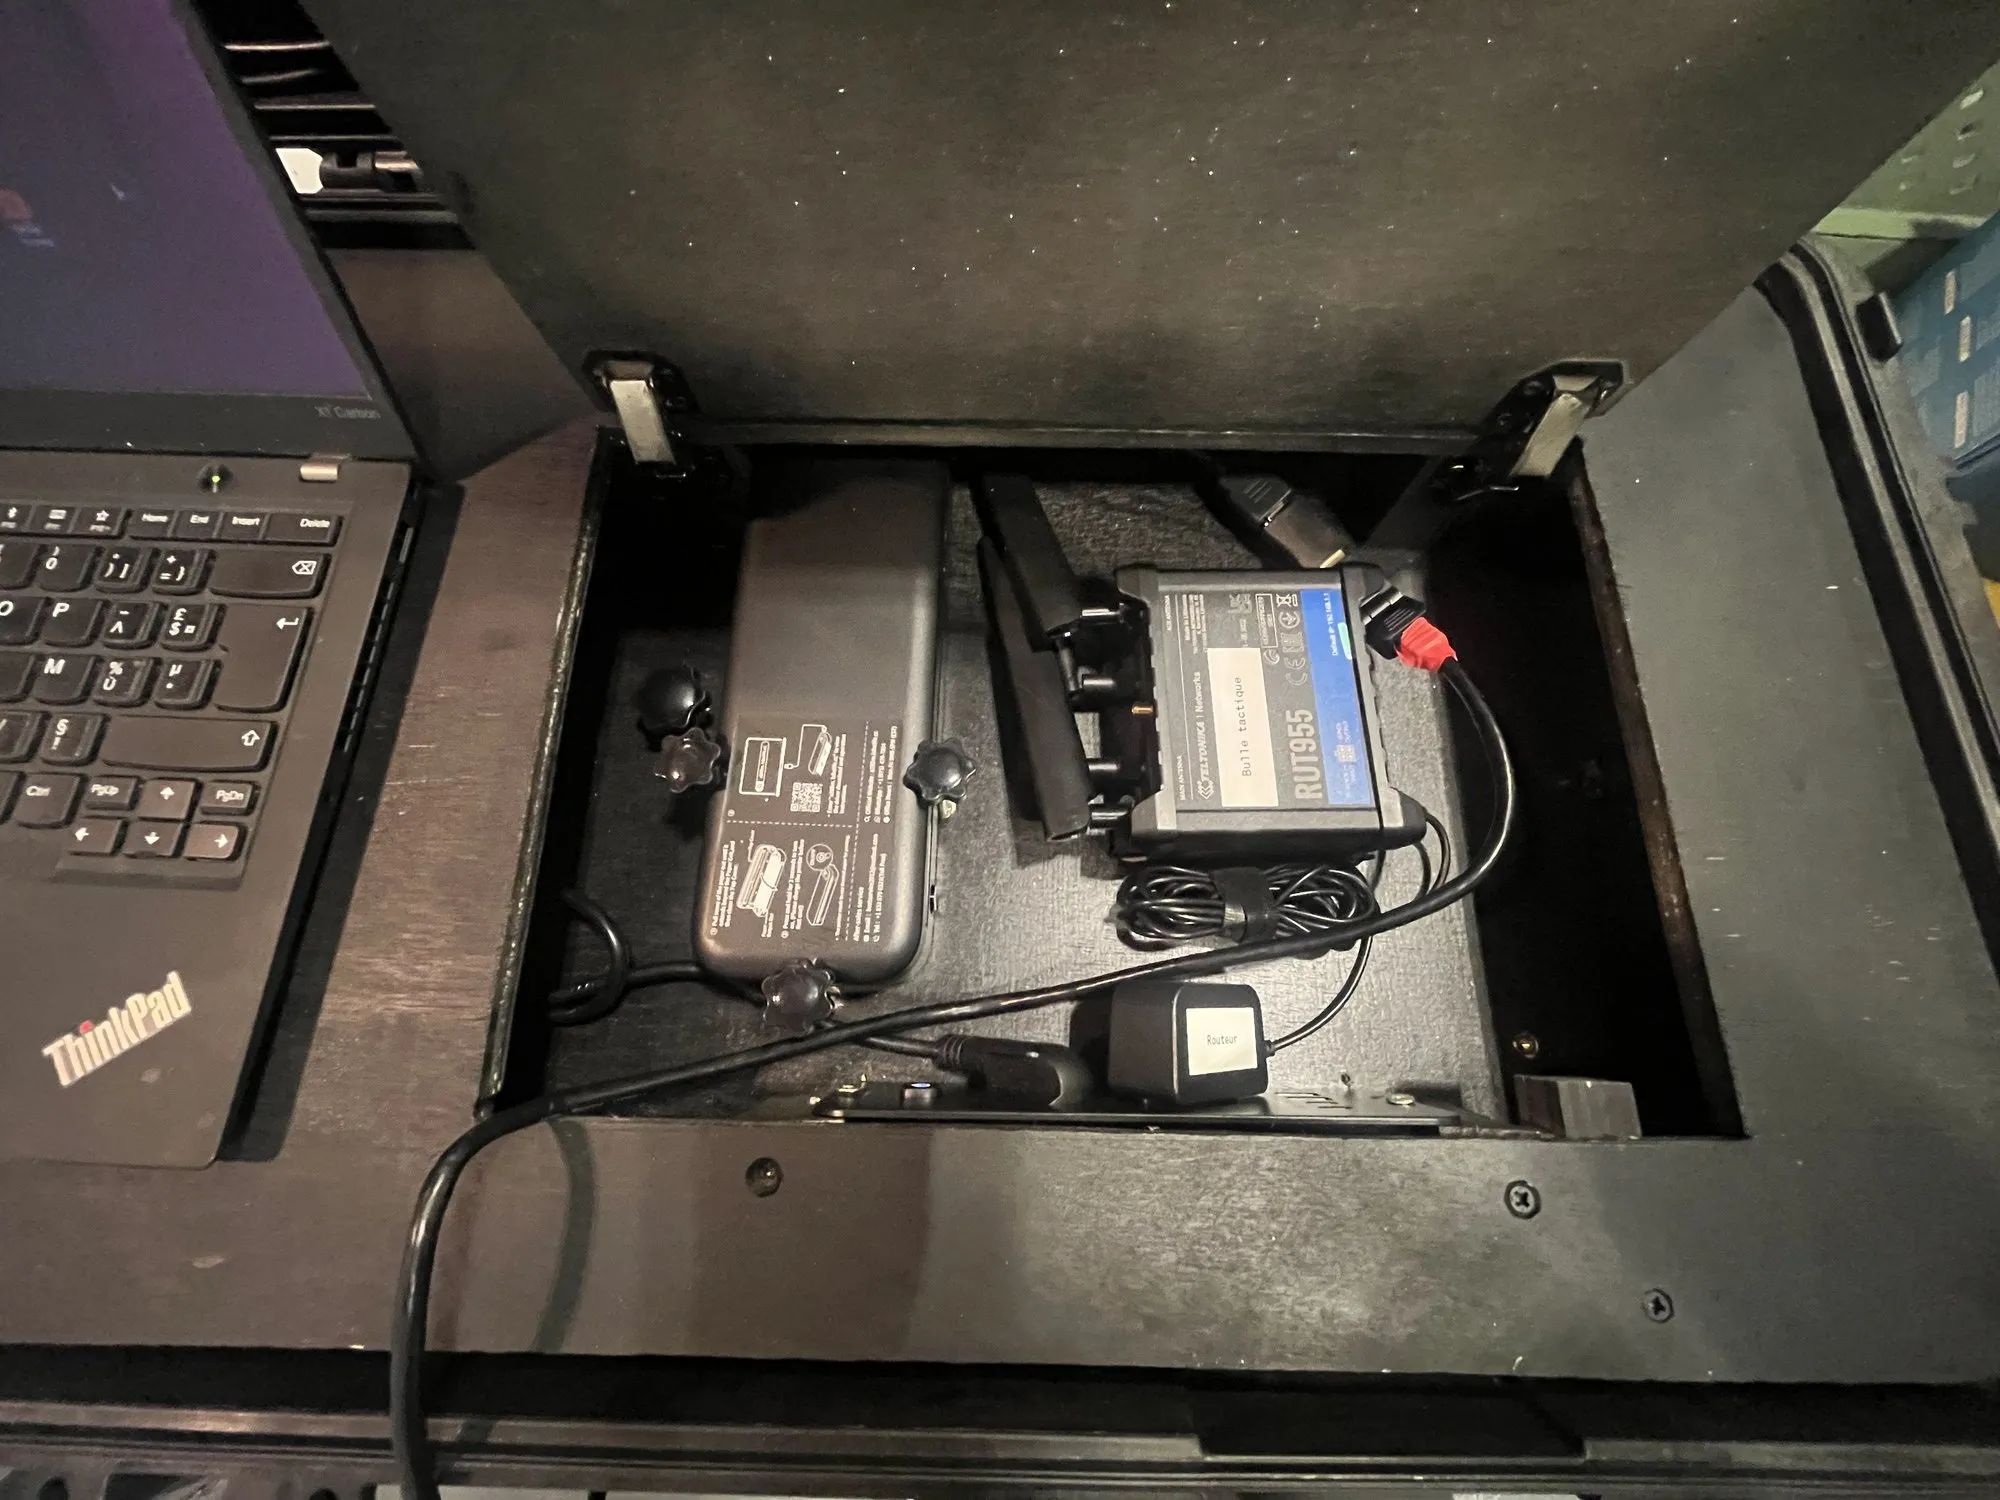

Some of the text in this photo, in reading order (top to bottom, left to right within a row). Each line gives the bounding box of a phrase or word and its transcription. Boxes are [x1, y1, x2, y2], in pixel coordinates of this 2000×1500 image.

[300, 518, 331, 529] Delete
[52, 602, 70, 618] P
[43, 658, 66, 674] M
[1194, 671, 1209, 781] TELTONIKA Networks
[1236, 677, 1252, 777] Bulle tactique
[1286, 709, 1323, 800] RUT955
[215, 789, 245, 802] PgDn
[41, 970, 192, 1088] ThinkPad
[1206, 1034, 1238, 1046] Routeur
